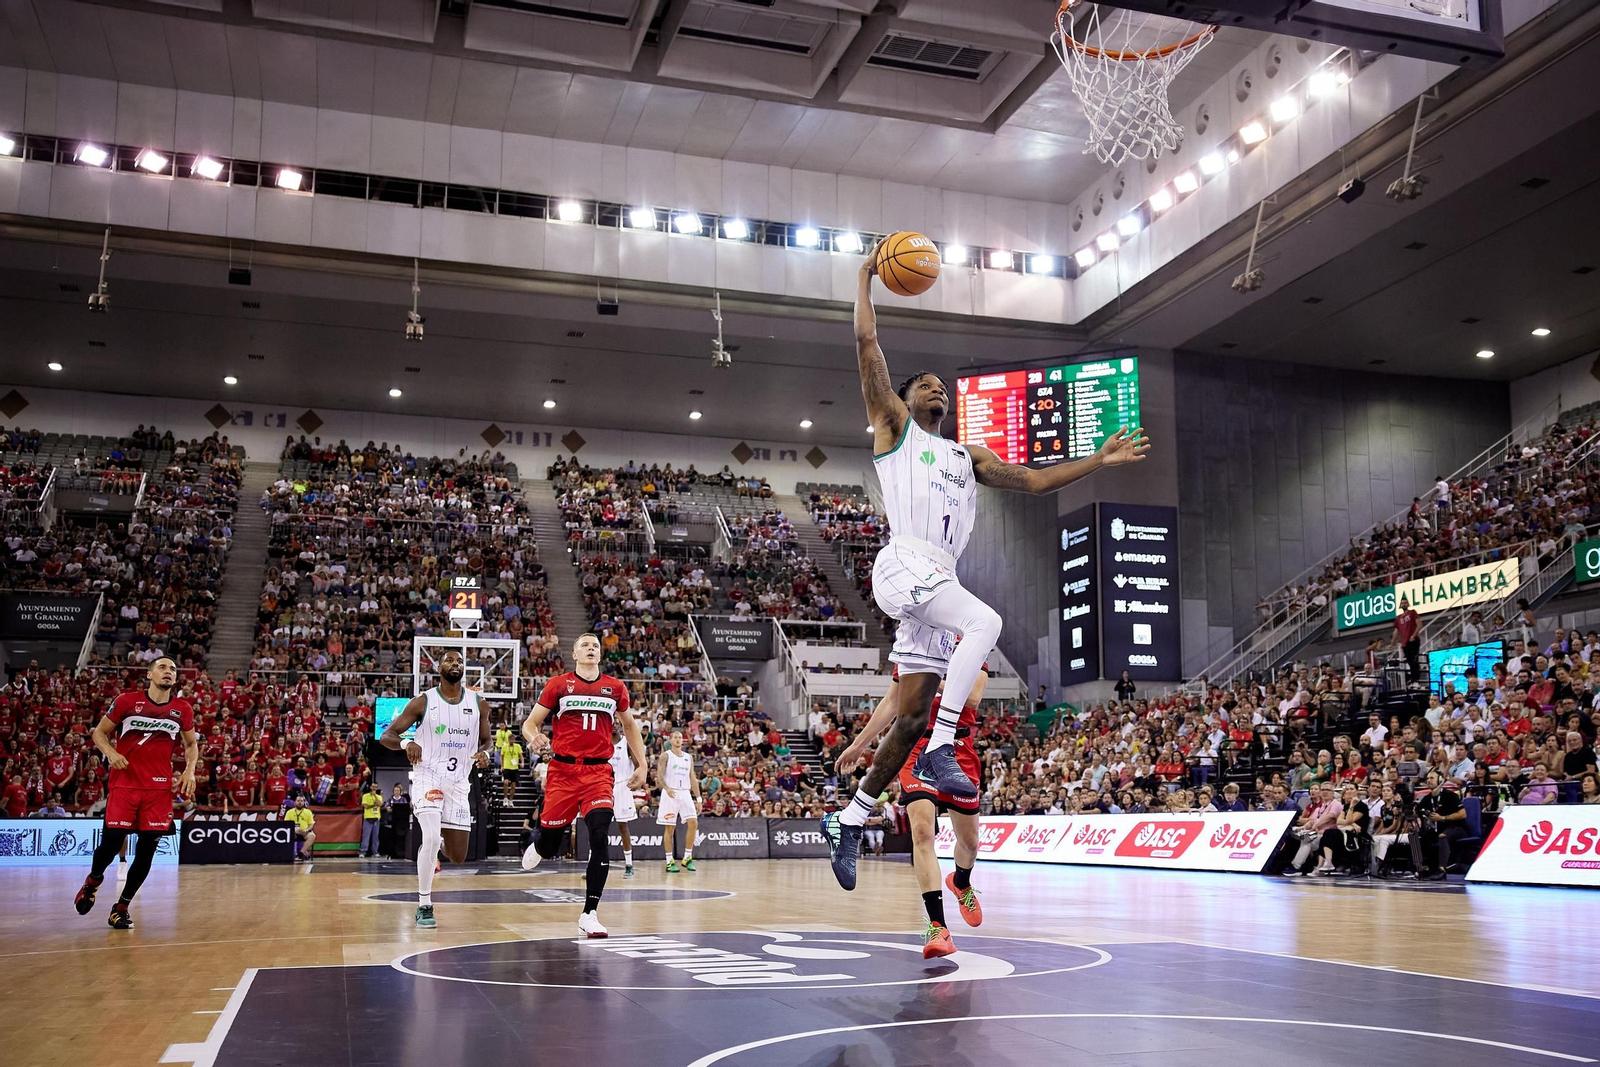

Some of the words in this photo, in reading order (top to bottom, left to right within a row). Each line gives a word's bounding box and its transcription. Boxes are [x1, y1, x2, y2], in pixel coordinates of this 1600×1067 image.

[1037, 398, 1054, 410] 2Q
[1033, 441, 1042, 453] 5
[1053, 438, 1062, 450] 5
[455, 577, 477, 587] 57.4
[455, 592, 477, 609] 21
[1344, 593, 1395, 626] grúas
[1399, 569, 1509, 609] ALHAMBRA
[16, 603, 81, 613] AYUNTAMIENTO
[35, 612, 75, 621] GRANADA
[712, 627, 762, 637] AYUNTAMIENTO
[725, 636, 757, 644] GRANADA
[566, 699, 612, 710] COVIRAN
[130, 720, 176, 731] COVIRAN
[582, 713, 597, 731] 11
[138, 732, 152, 746] 7
[447, 757, 458, 772] 3
[188, 823, 291, 844] endesa
[708, 832, 729, 840] CAJA
[730, 832, 759, 840] RURAL
[1025, 828, 1056, 844] ASC
[1081, 828, 1116, 846] ASC
[1145, 828, 1187, 848] ASC
[1222, 828, 1268, 849] ASC
[1543, 828, 1600, 856] AS
[571, 936, 857, 986] PULEVA
